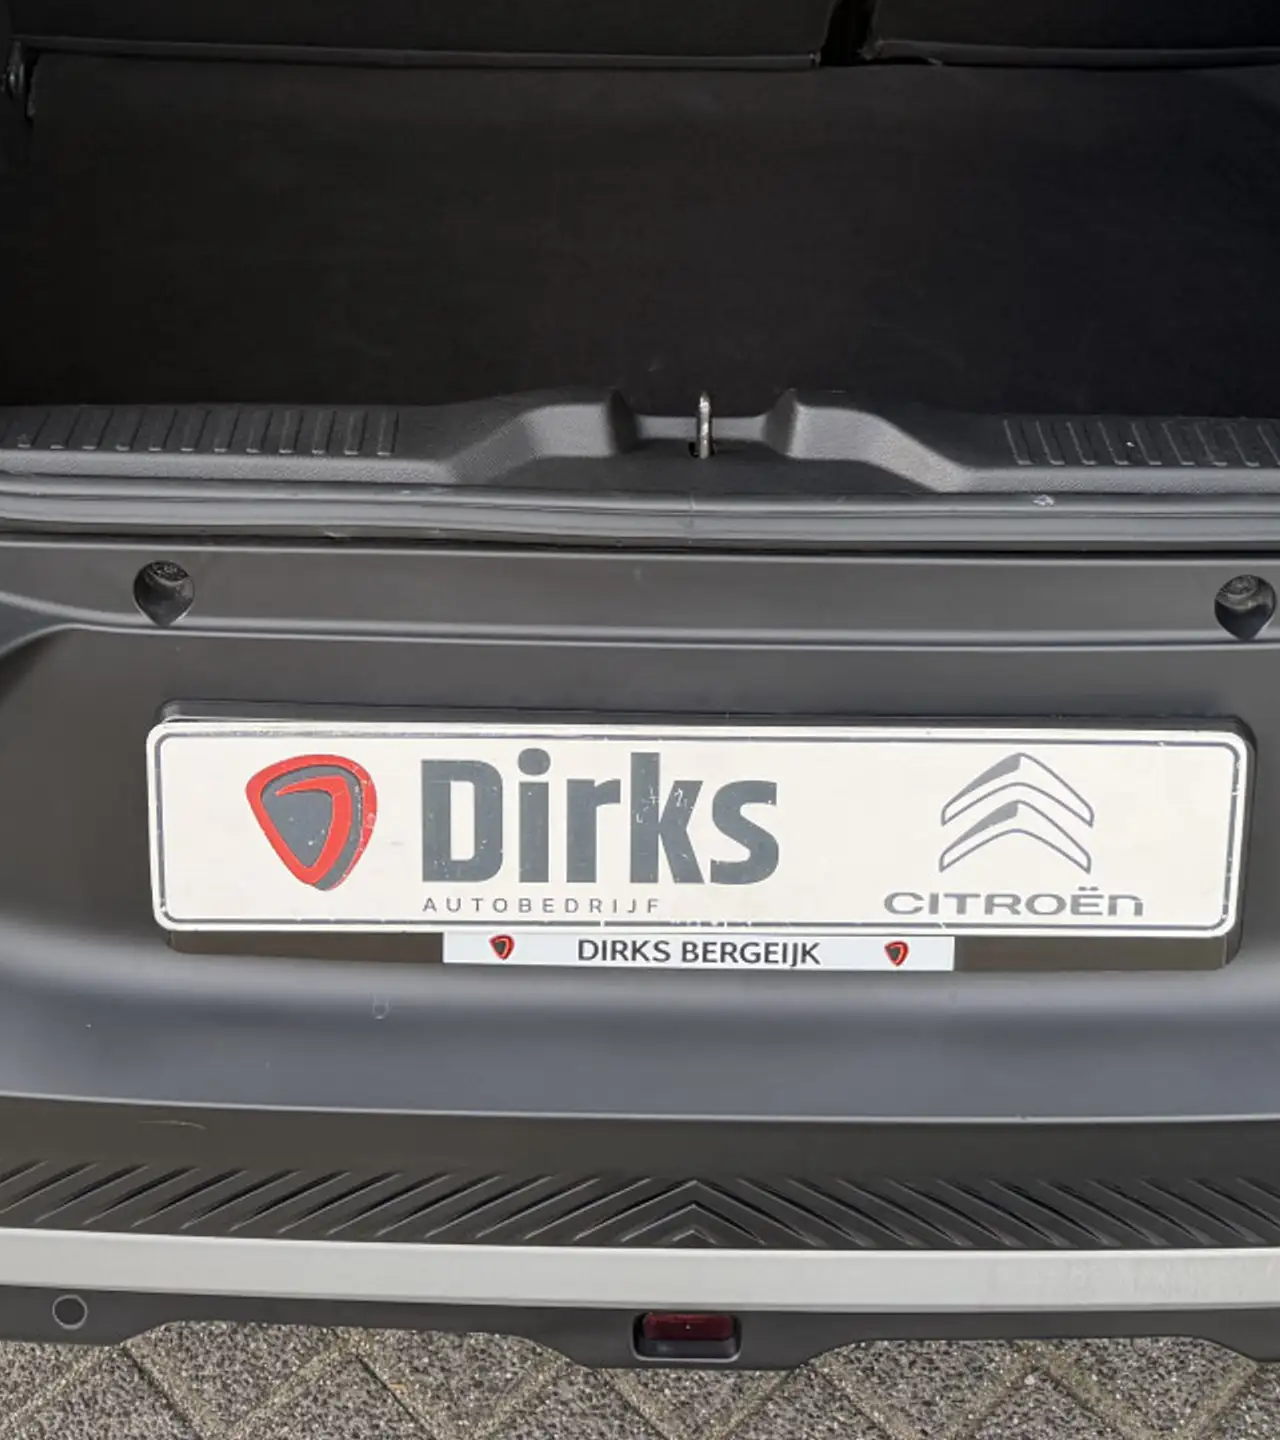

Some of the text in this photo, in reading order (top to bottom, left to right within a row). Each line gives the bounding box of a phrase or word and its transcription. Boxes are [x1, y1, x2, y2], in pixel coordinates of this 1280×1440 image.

[421, 748, 779, 885] Dirks
[422, 897, 661, 914] AUTOBEDRIJF
[578, 939, 821, 968] DIRKS BERGEIJK
